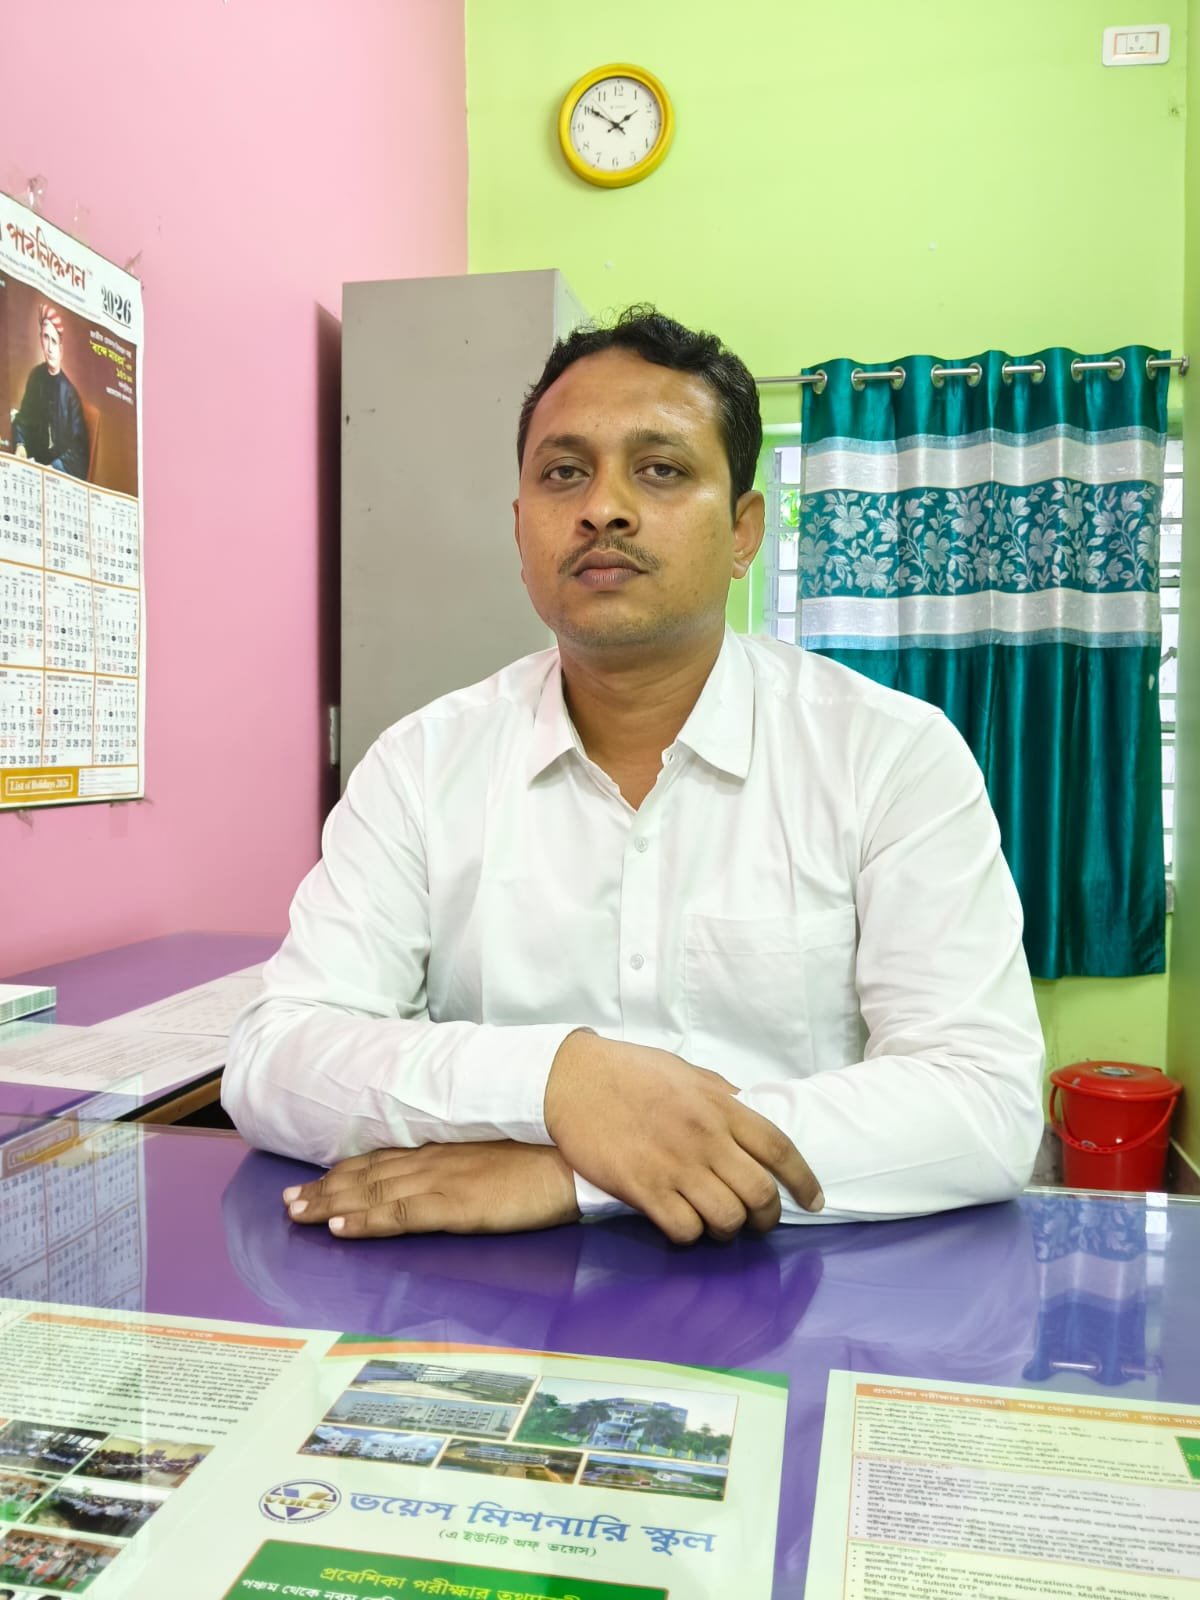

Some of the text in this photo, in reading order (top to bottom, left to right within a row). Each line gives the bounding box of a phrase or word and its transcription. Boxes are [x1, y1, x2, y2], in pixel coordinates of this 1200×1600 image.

[101, 286, 132, 325] 2026
[265, 1495, 333, 1511] VOICE
[350, 1492, 717, 1556] ভয়েস মিশনারি স্কুল
[463, 1530, 509, 1546] ইউনিট
[242, 1578, 280, 1593] পঞ্চম
[282, 1584, 321, 1598] থেকে
[320, 1567, 408, 1590] প্রবেশিকা
[413, 1577, 492, 1600] পরীক্ষার
[864, 1572, 887, 1580] Send
[922, 1578, 956, 1588] Submit
[908, 1570, 935, 1579] Apply
[973, 1577, 1012, 1588] Register
[1015, 1583, 1037, 1591] Now
[911, 1585, 938, 1595] Login
